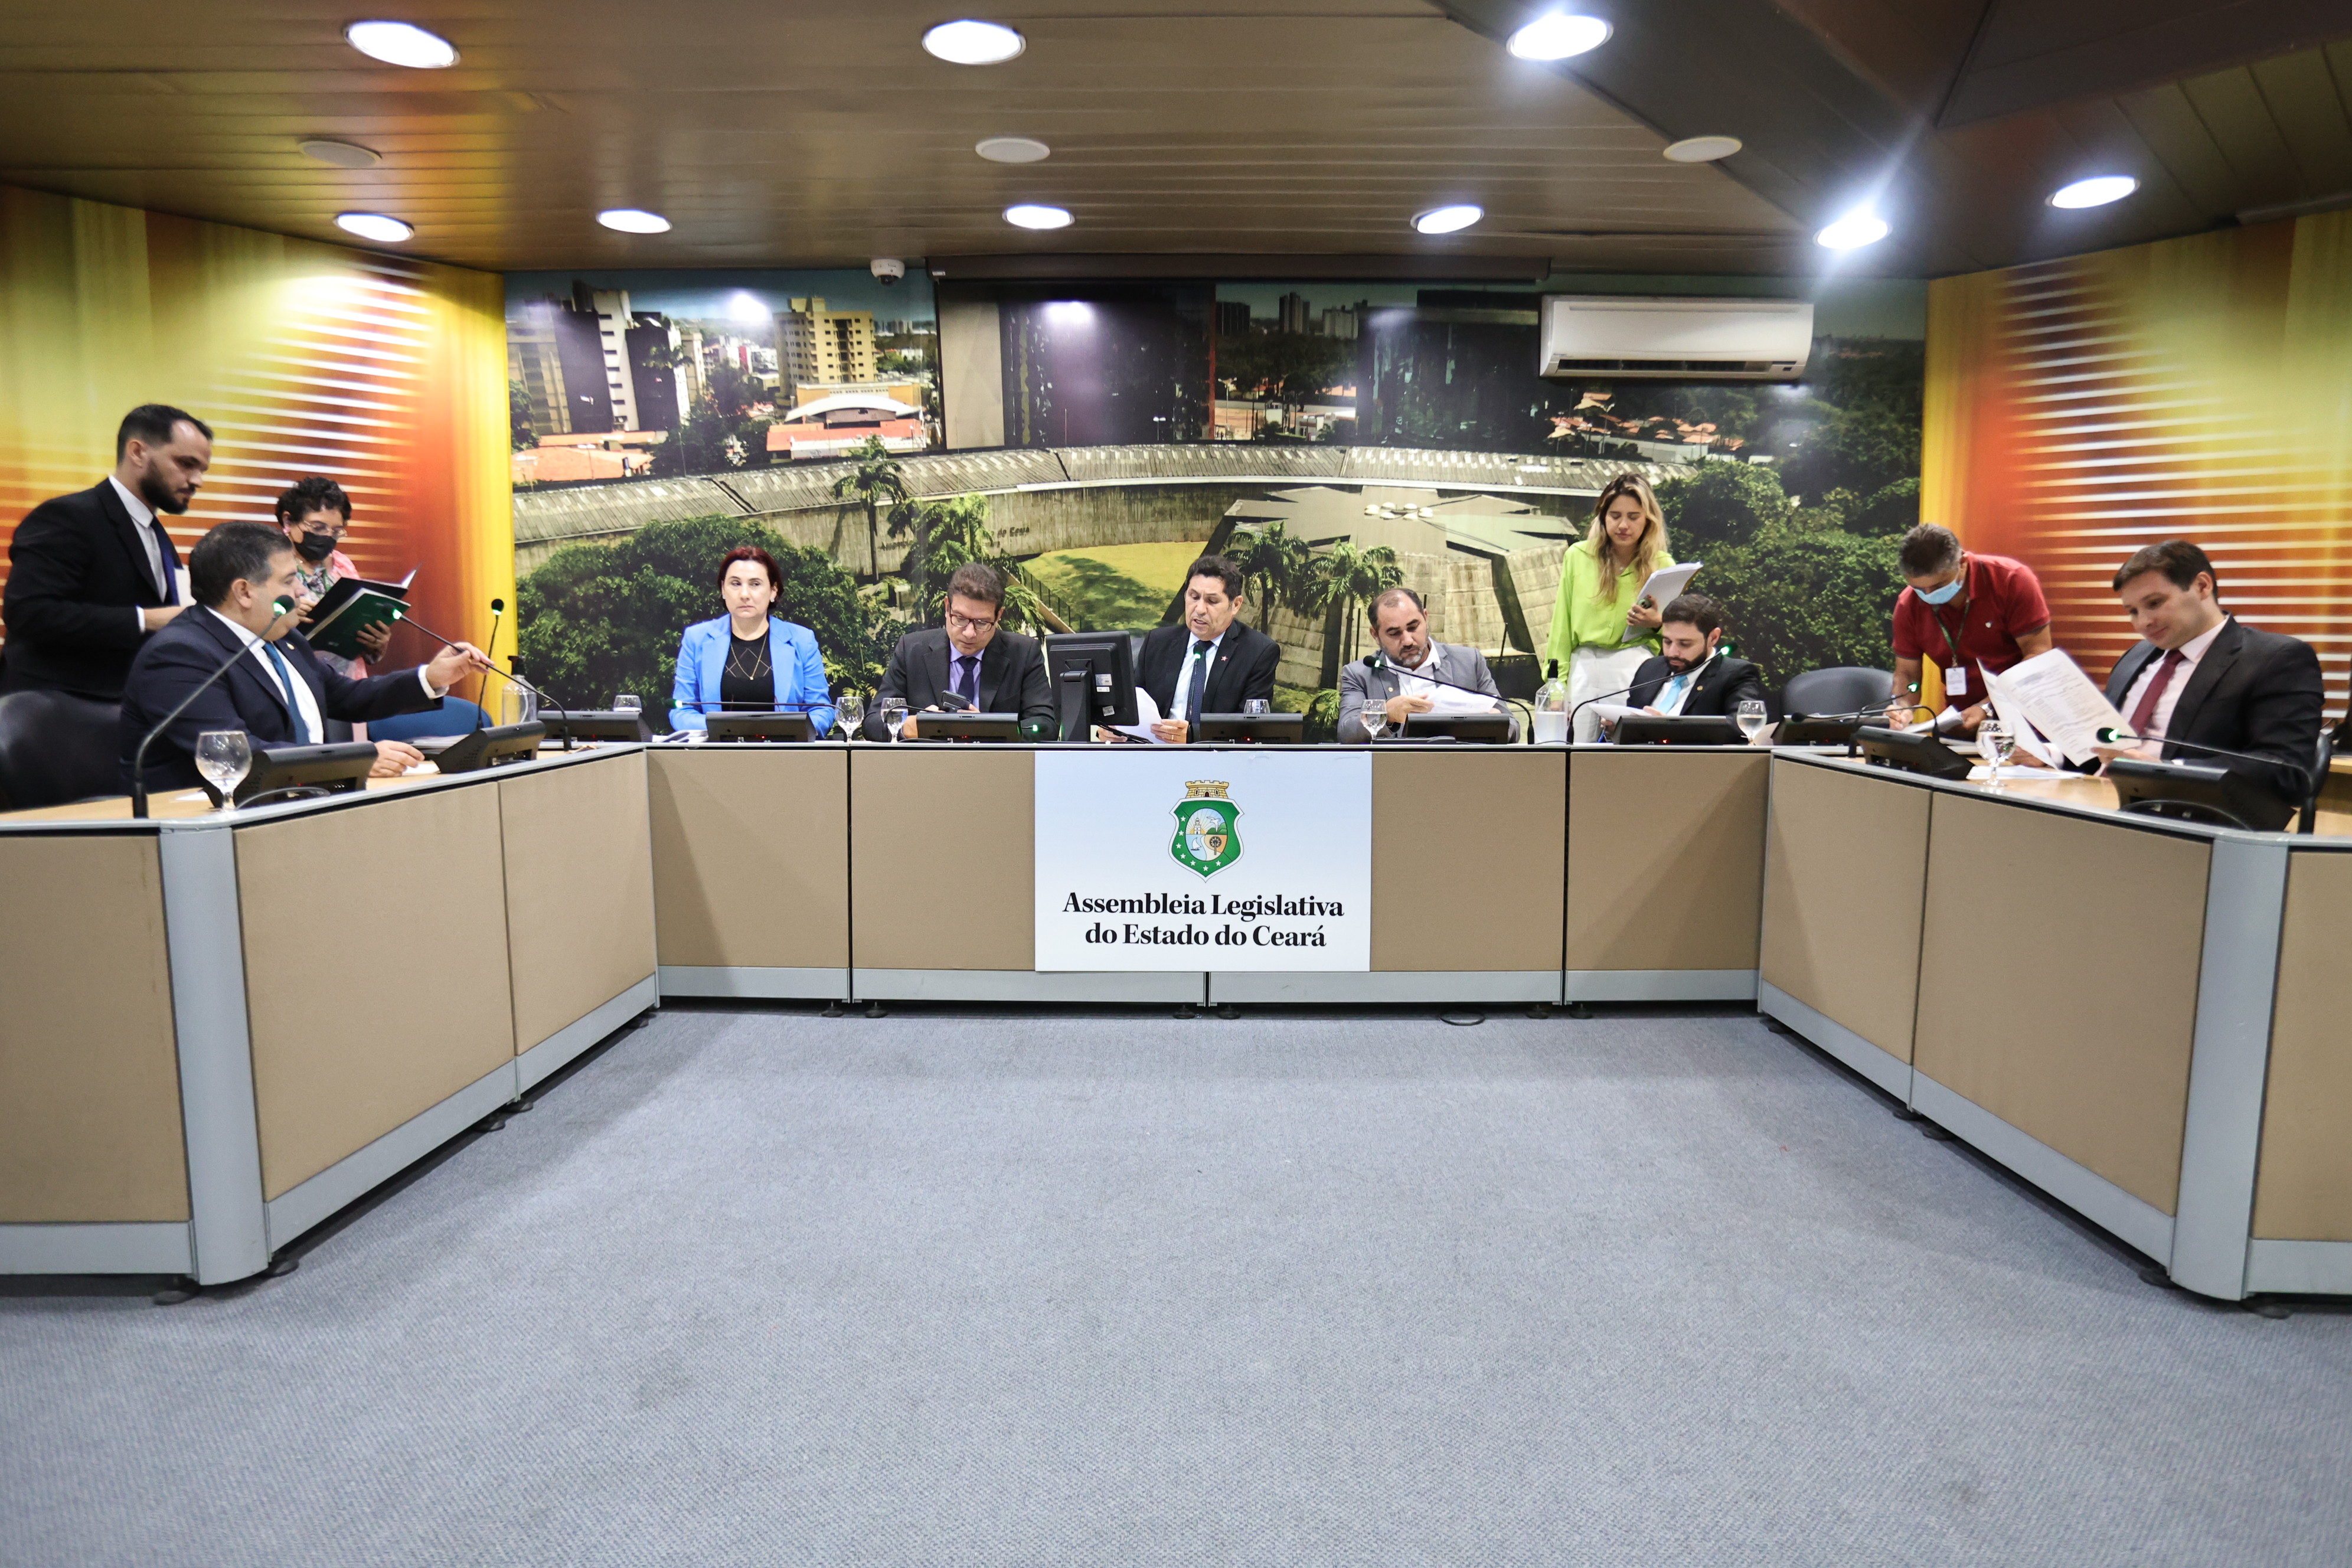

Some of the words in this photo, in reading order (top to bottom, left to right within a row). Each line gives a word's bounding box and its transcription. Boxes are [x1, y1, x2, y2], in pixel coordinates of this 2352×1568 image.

[1062, 892, 1207, 915] Assembleia
[1210, 894, 1345, 922] Legislativa
[1085, 922, 1118, 944] do
[1123, 923, 1209, 945] Estado
[1214, 924, 1247, 946] do
[1253, 925, 1327, 947] Ceará
